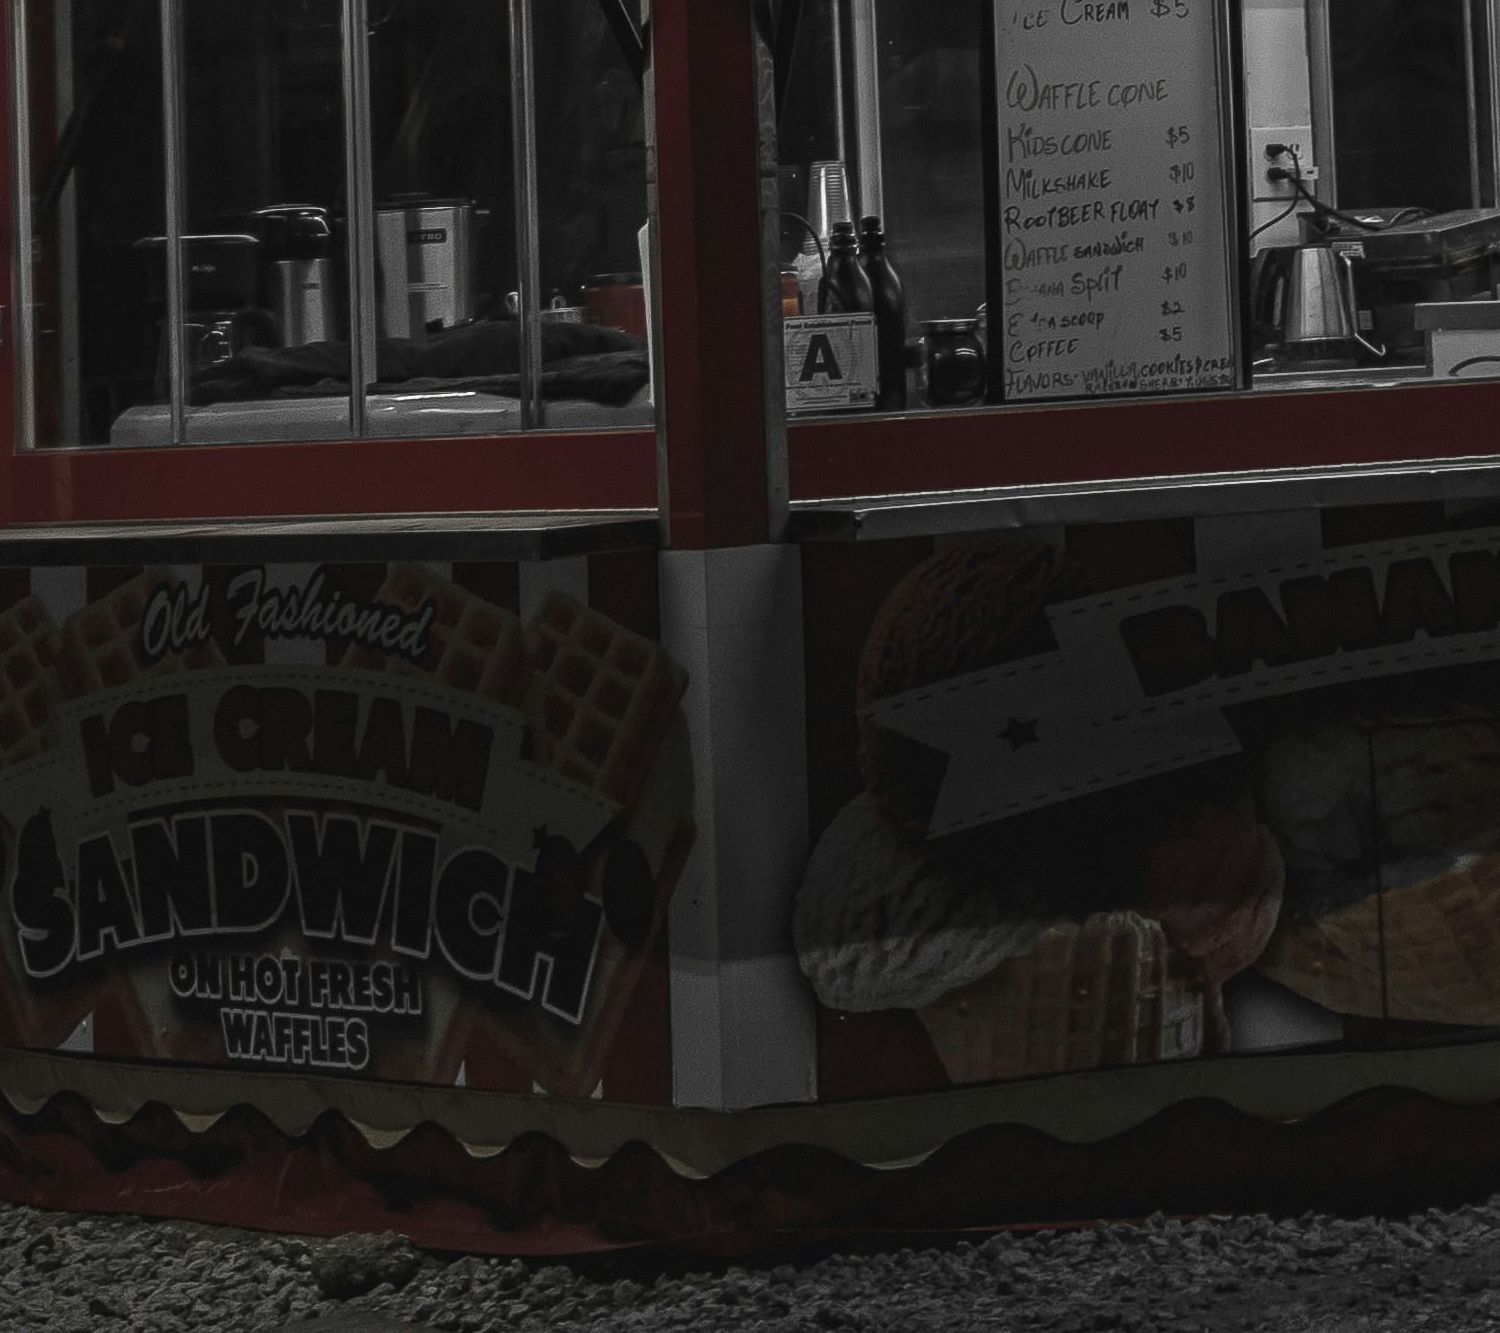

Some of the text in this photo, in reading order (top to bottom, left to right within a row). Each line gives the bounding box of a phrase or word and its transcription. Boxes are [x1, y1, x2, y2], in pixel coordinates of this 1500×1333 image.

[1006, 64, 1169, 112] WAFFLE CONE
[1165, 125, 1191, 149] $5
[1168, 162, 1195, 184] $10
[1110, 198, 1160, 223] FLOAT
[1161, 262, 1188, 285] $10
[799, 334, 843, 381] A
[1009, 337, 1080, 364] COFFEE
[142, 567, 436, 658] Old Fashioned
[80, 685, 497, 812] ICE CREAM
[11, 808, 605, 1026] SANDWICH
[170, 952, 424, 1016] ON HOT FRESH
[220, 1009, 370, 1070] WAFFLES
